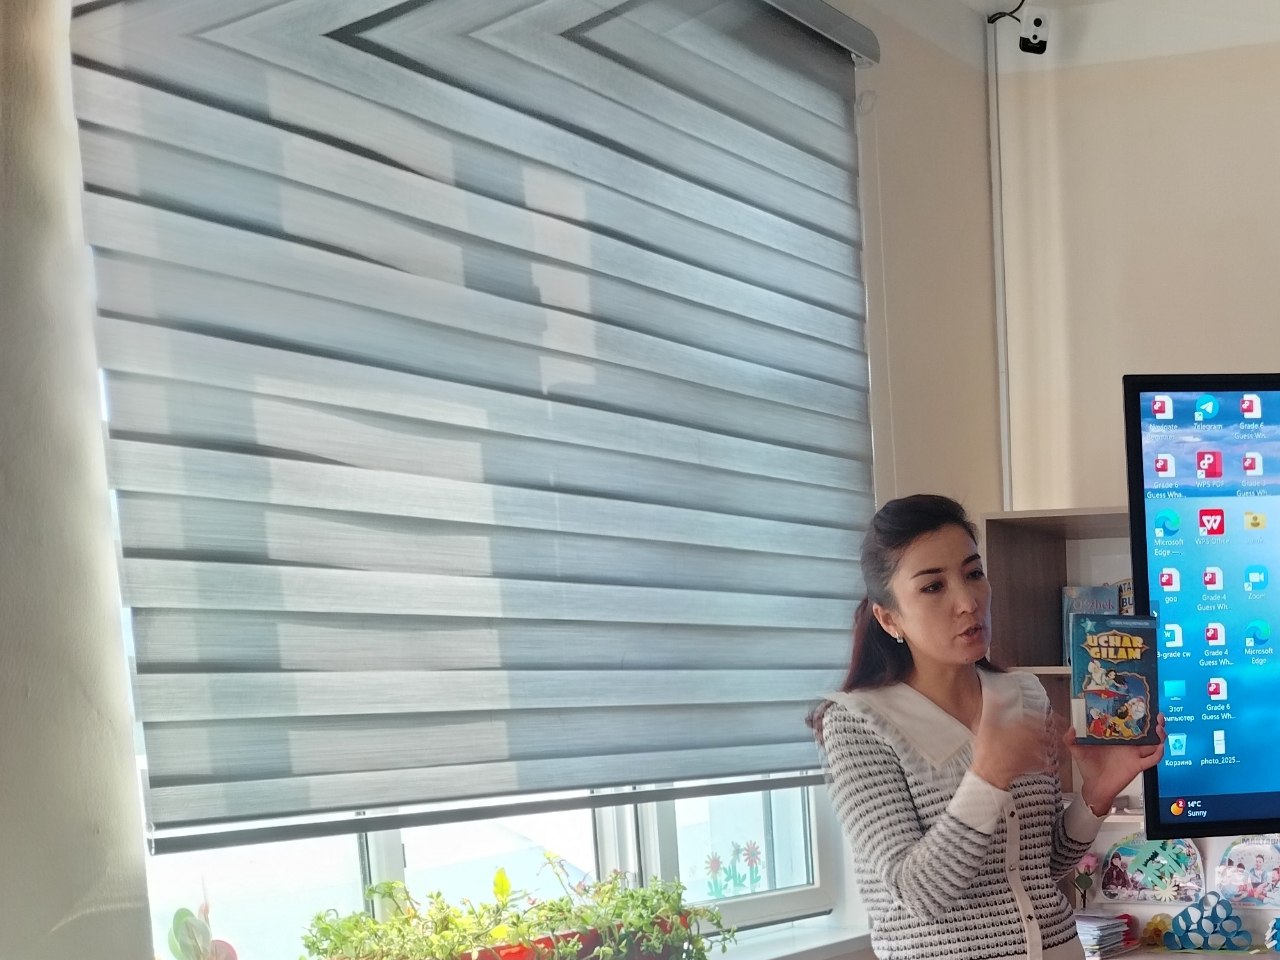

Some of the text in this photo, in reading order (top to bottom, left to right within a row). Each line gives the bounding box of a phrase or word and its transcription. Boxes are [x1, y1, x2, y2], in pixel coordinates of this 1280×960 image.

[1194, 422, 1223, 431] Telegram
[1240, 421, 1258, 430] Grade
[1196, 480, 1211, 488] WPS
[1147, 491, 1165, 499] Guess
[1154, 538, 1184, 546] Microsoft
[1195, 537, 1209, 546] WPS
[1154, 548, 1171, 556] Edge
[1087, 635, 1144, 647] UCHAR
[1090, 648, 1142, 660] GILAM
[1204, 649, 1221, 657] Grade
[1244, 647, 1273, 655] Microsoft
[1199, 659, 1217, 667] Guess
[1252, 657, 1267, 665] Edge
[1169, 705, 1184, 713] Этот
[1165, 760, 1193, 768] Корзина
[1187, 809, 1207, 818] Sunny
